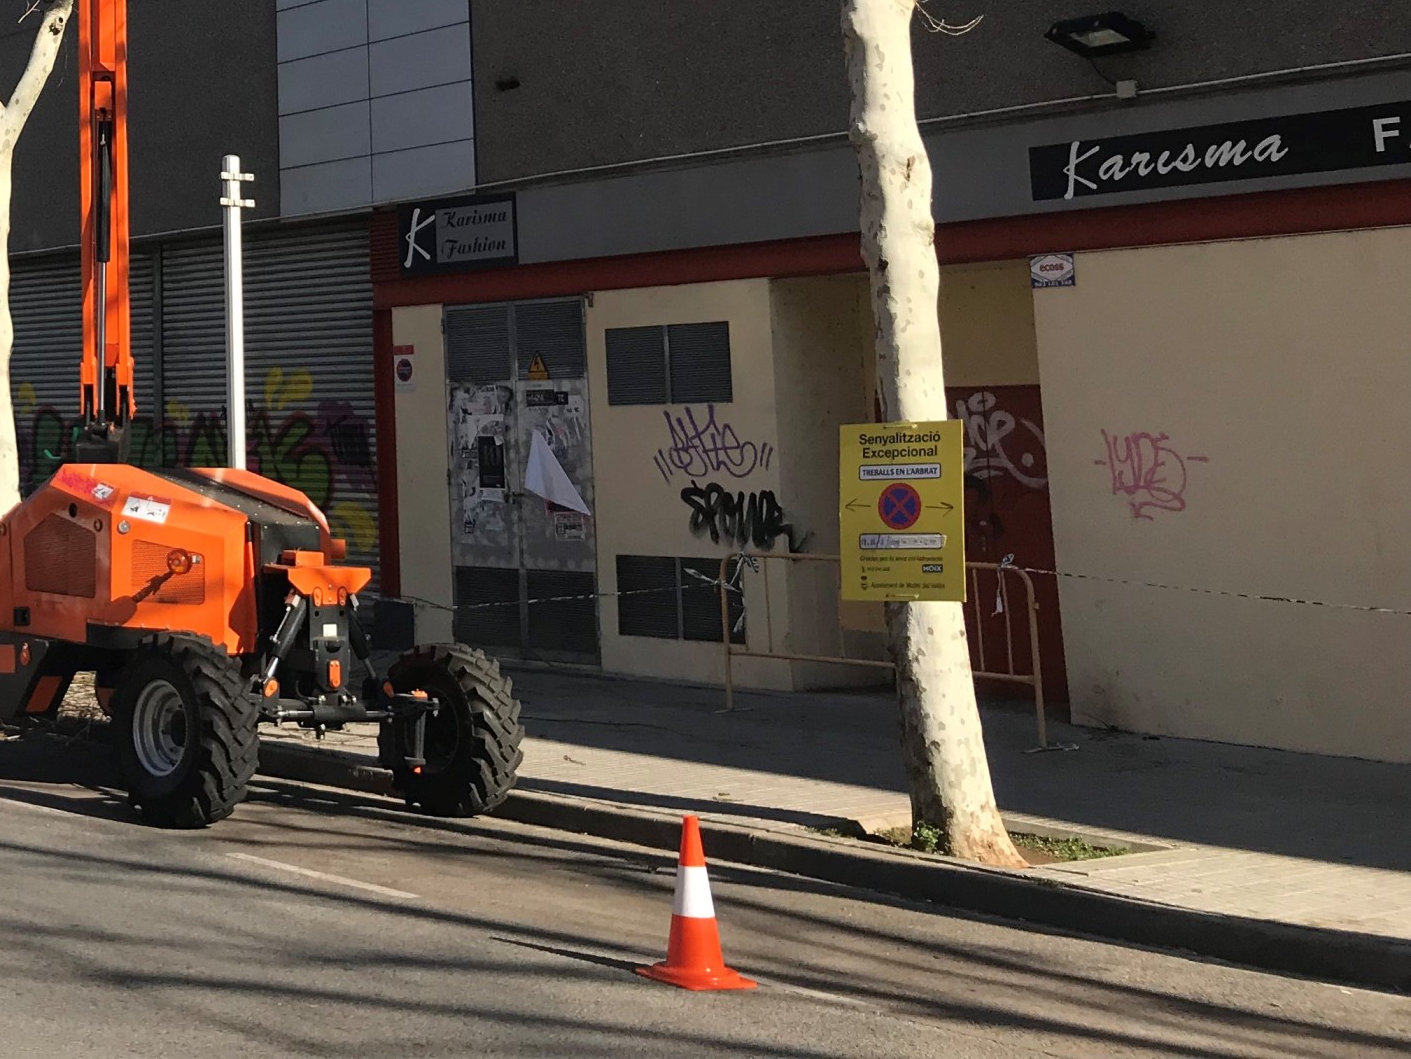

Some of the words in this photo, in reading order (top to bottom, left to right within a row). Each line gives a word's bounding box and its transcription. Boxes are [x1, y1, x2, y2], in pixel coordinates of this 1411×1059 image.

[1063, 134, 1289, 200] Karisma
[441, 209, 507, 229] Karisma
[404, 208, 436, 268] K
[443, 236, 507, 259] Fashion
[859, 430, 941, 447] Senyalització
[862, 445, 938, 460] Excepcional
[862, 468, 894, 476] TREBALLS
[895, 468, 905, 476] EN
[906, 467, 938, 475] L'ARBRAT
